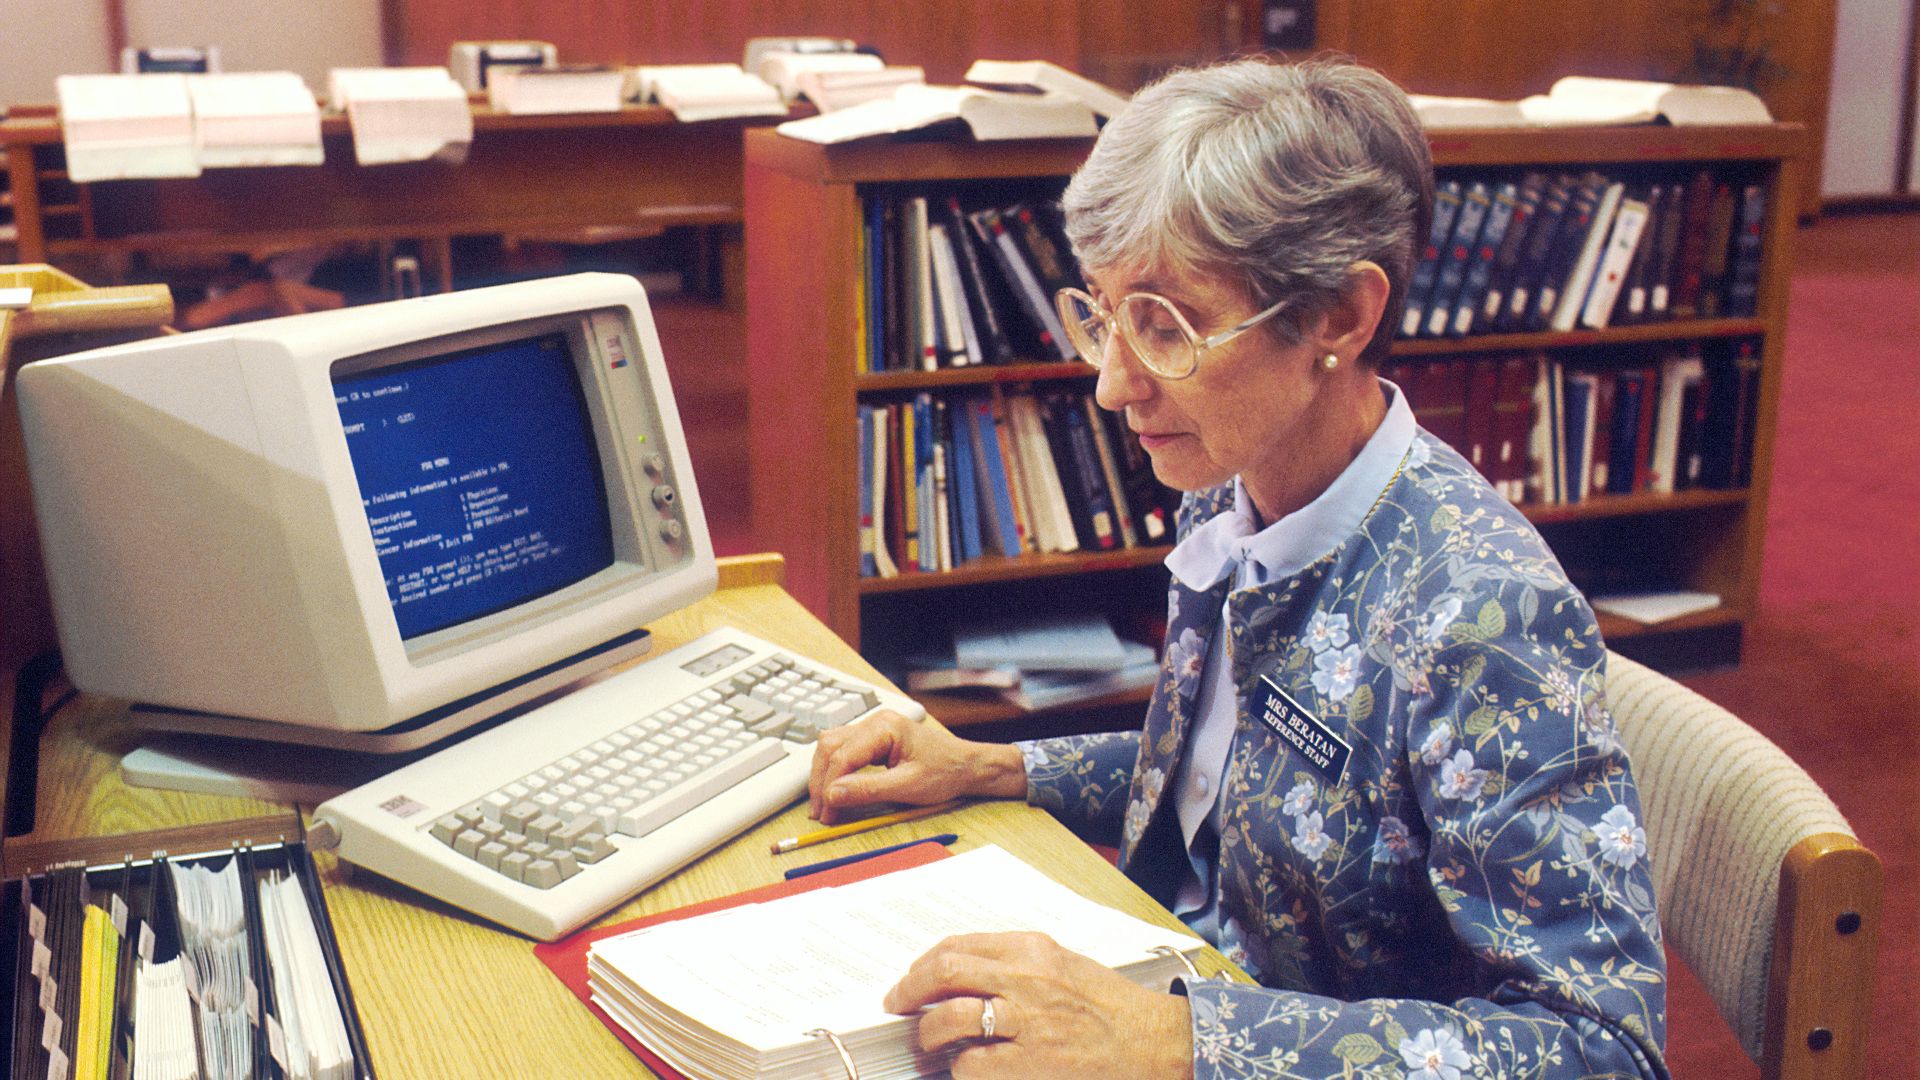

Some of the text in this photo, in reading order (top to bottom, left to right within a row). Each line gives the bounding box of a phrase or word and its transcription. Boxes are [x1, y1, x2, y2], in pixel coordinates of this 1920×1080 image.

[362, 391, 371, 399] to
[434, 457, 450, 467] MENU
[372, 490, 407, 504] following
[409, 480, 448, 496] information
[450, 476, 457, 485] is
[460, 468, 488, 482] available
[466, 486, 498, 500] Physicians
[469, 493, 508, 510] Organizations
[369, 510, 412, 526] Description
[471, 505, 500, 519] Protocols
[485, 511, 513, 526] Editorial
[514, 506, 529, 517] Board
[373, 519, 417, 536] Instructions
[376, 533, 442, 557] Cancer Information
[446, 537, 460, 548] Exit
[408, 572, 420, 581] any
[436, 559, 457, 574] prompt
[475, 552, 486, 561] you
[500, 543, 512, 553] type
[431, 576, 439, 584] or
[441, 571, 456, 581] type
[474, 562, 481, 571] to
[401, 589, 426, 604] desired
[429, 583, 450, 595] number
[453, 576, 464, 588] and
[466, 573, 482, 585] press
[1265, 693, 1337, 759] MRS BERATAN
[1263, 710, 1330, 769] REFERENCE STAFF
